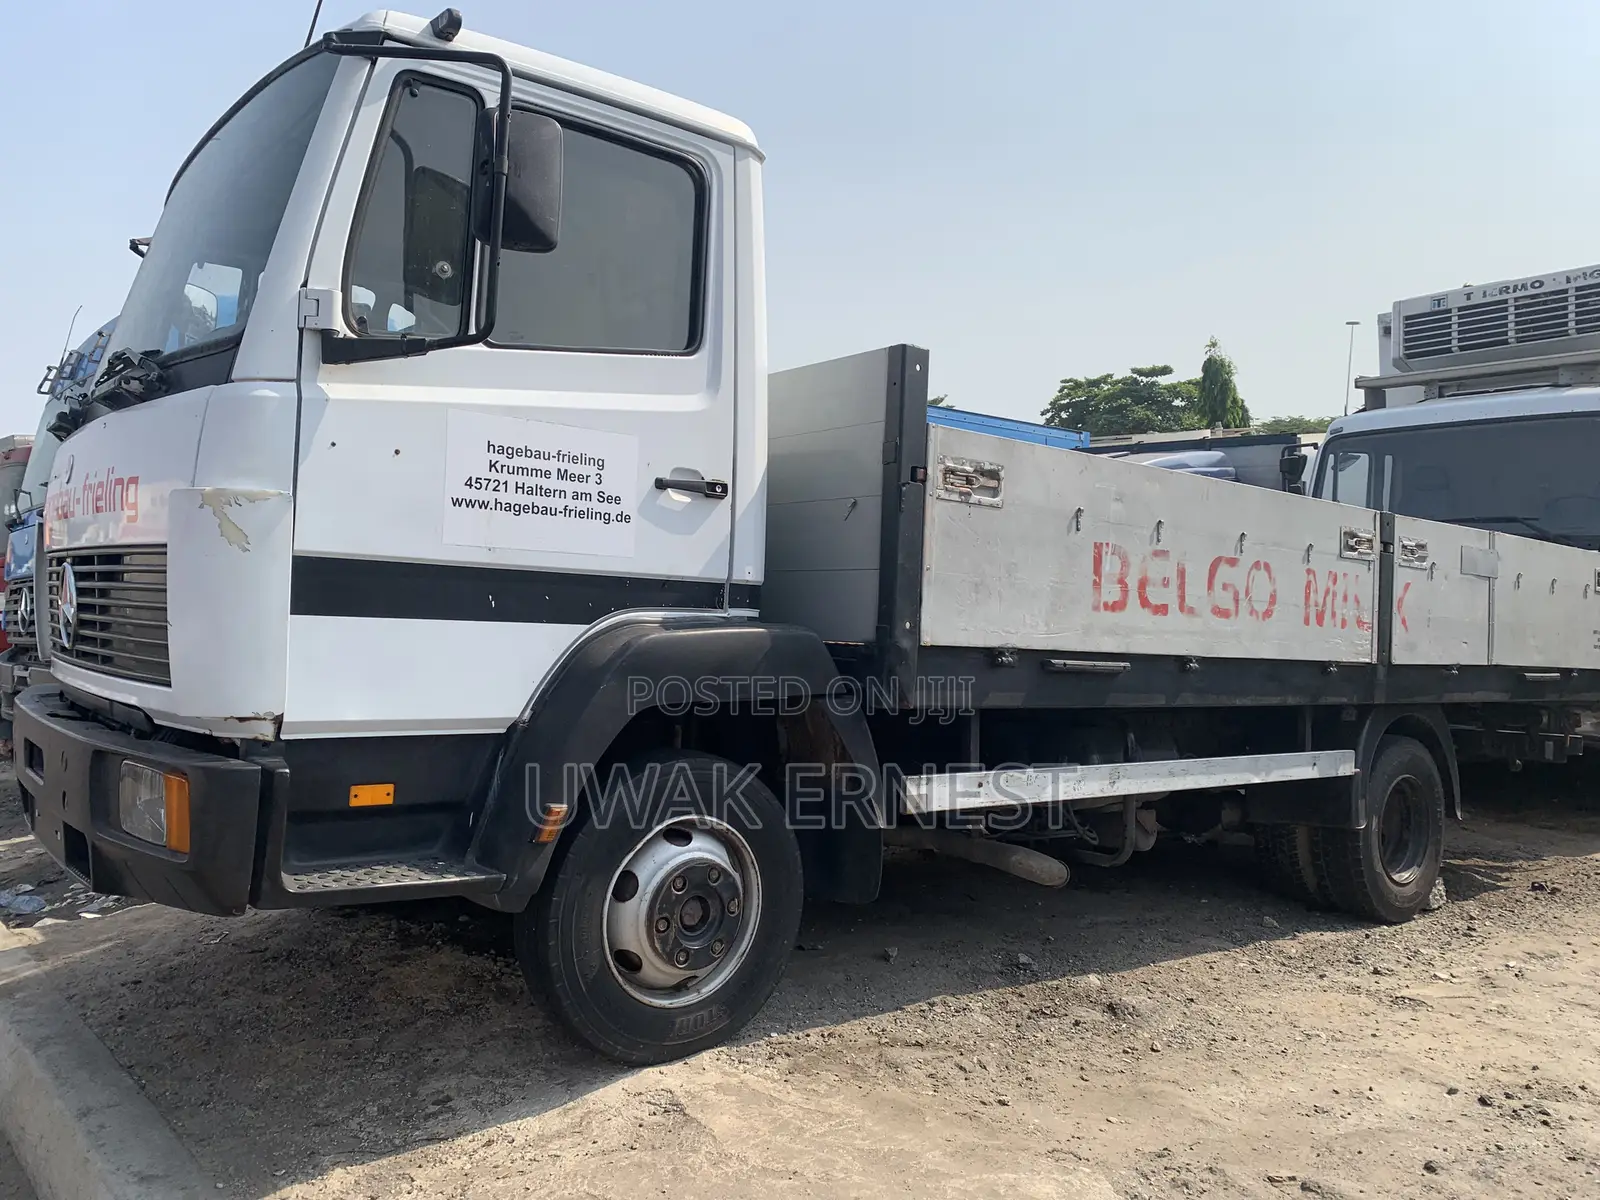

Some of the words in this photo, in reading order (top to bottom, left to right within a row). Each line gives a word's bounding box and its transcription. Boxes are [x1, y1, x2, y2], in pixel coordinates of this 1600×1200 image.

[487, 440, 605, 471] hagebau-frieling
[488, 459, 552, 480] Krumme
[556, 468, 591, 484] Meer
[594, 473, 603, 485] 3
[464, 476, 509, 493] 45721
[515, 481, 567, 499] Haltern
[571, 490, 592, 502] am
[596, 491, 622, 505] See
[450, 496, 632, 525] www.hagebau-frieling.de
[1092, 541, 1277, 622] BELGO
